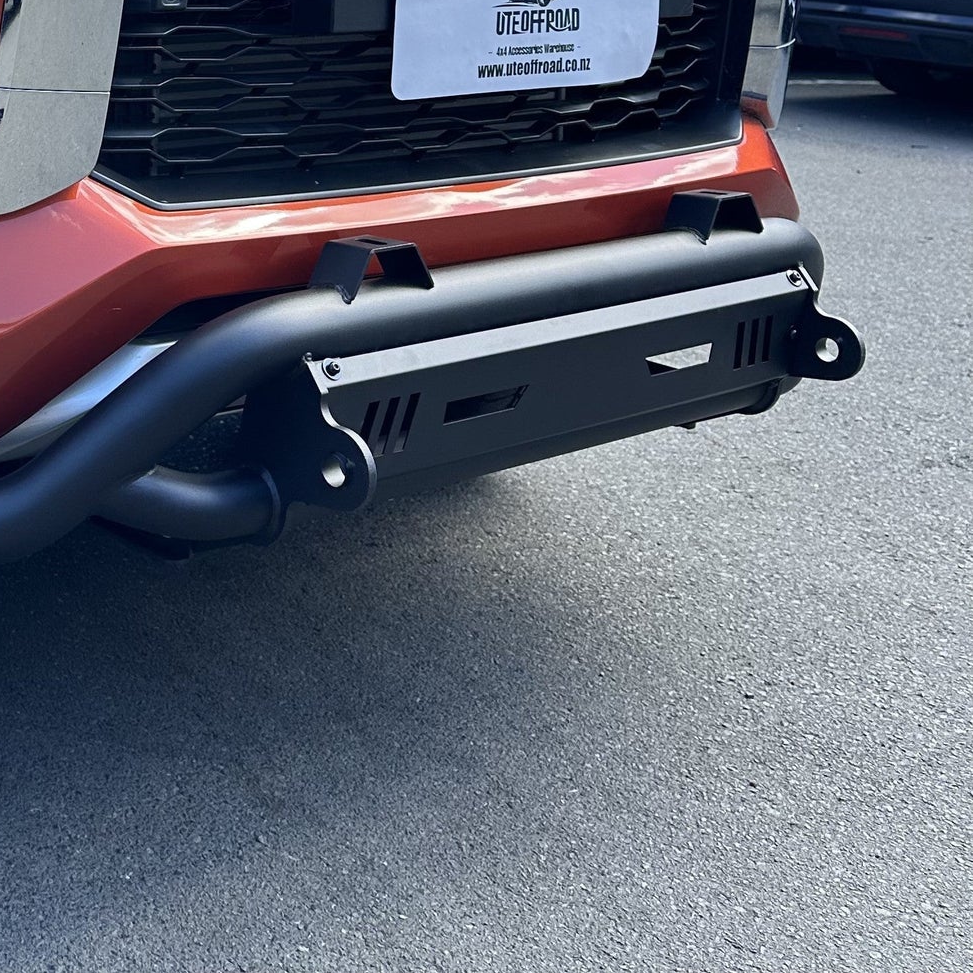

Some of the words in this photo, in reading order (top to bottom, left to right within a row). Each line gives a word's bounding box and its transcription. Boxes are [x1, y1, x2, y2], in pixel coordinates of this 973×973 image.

[496, 8, 580, 35] UTEOFFROAD
[496, 46, 507, 56] 4x4
[508, 44, 543, 56] Accessories
[544, 43, 574, 54] Warehouse
[478, 57, 591, 78] www.uteoffroad.co.nz
